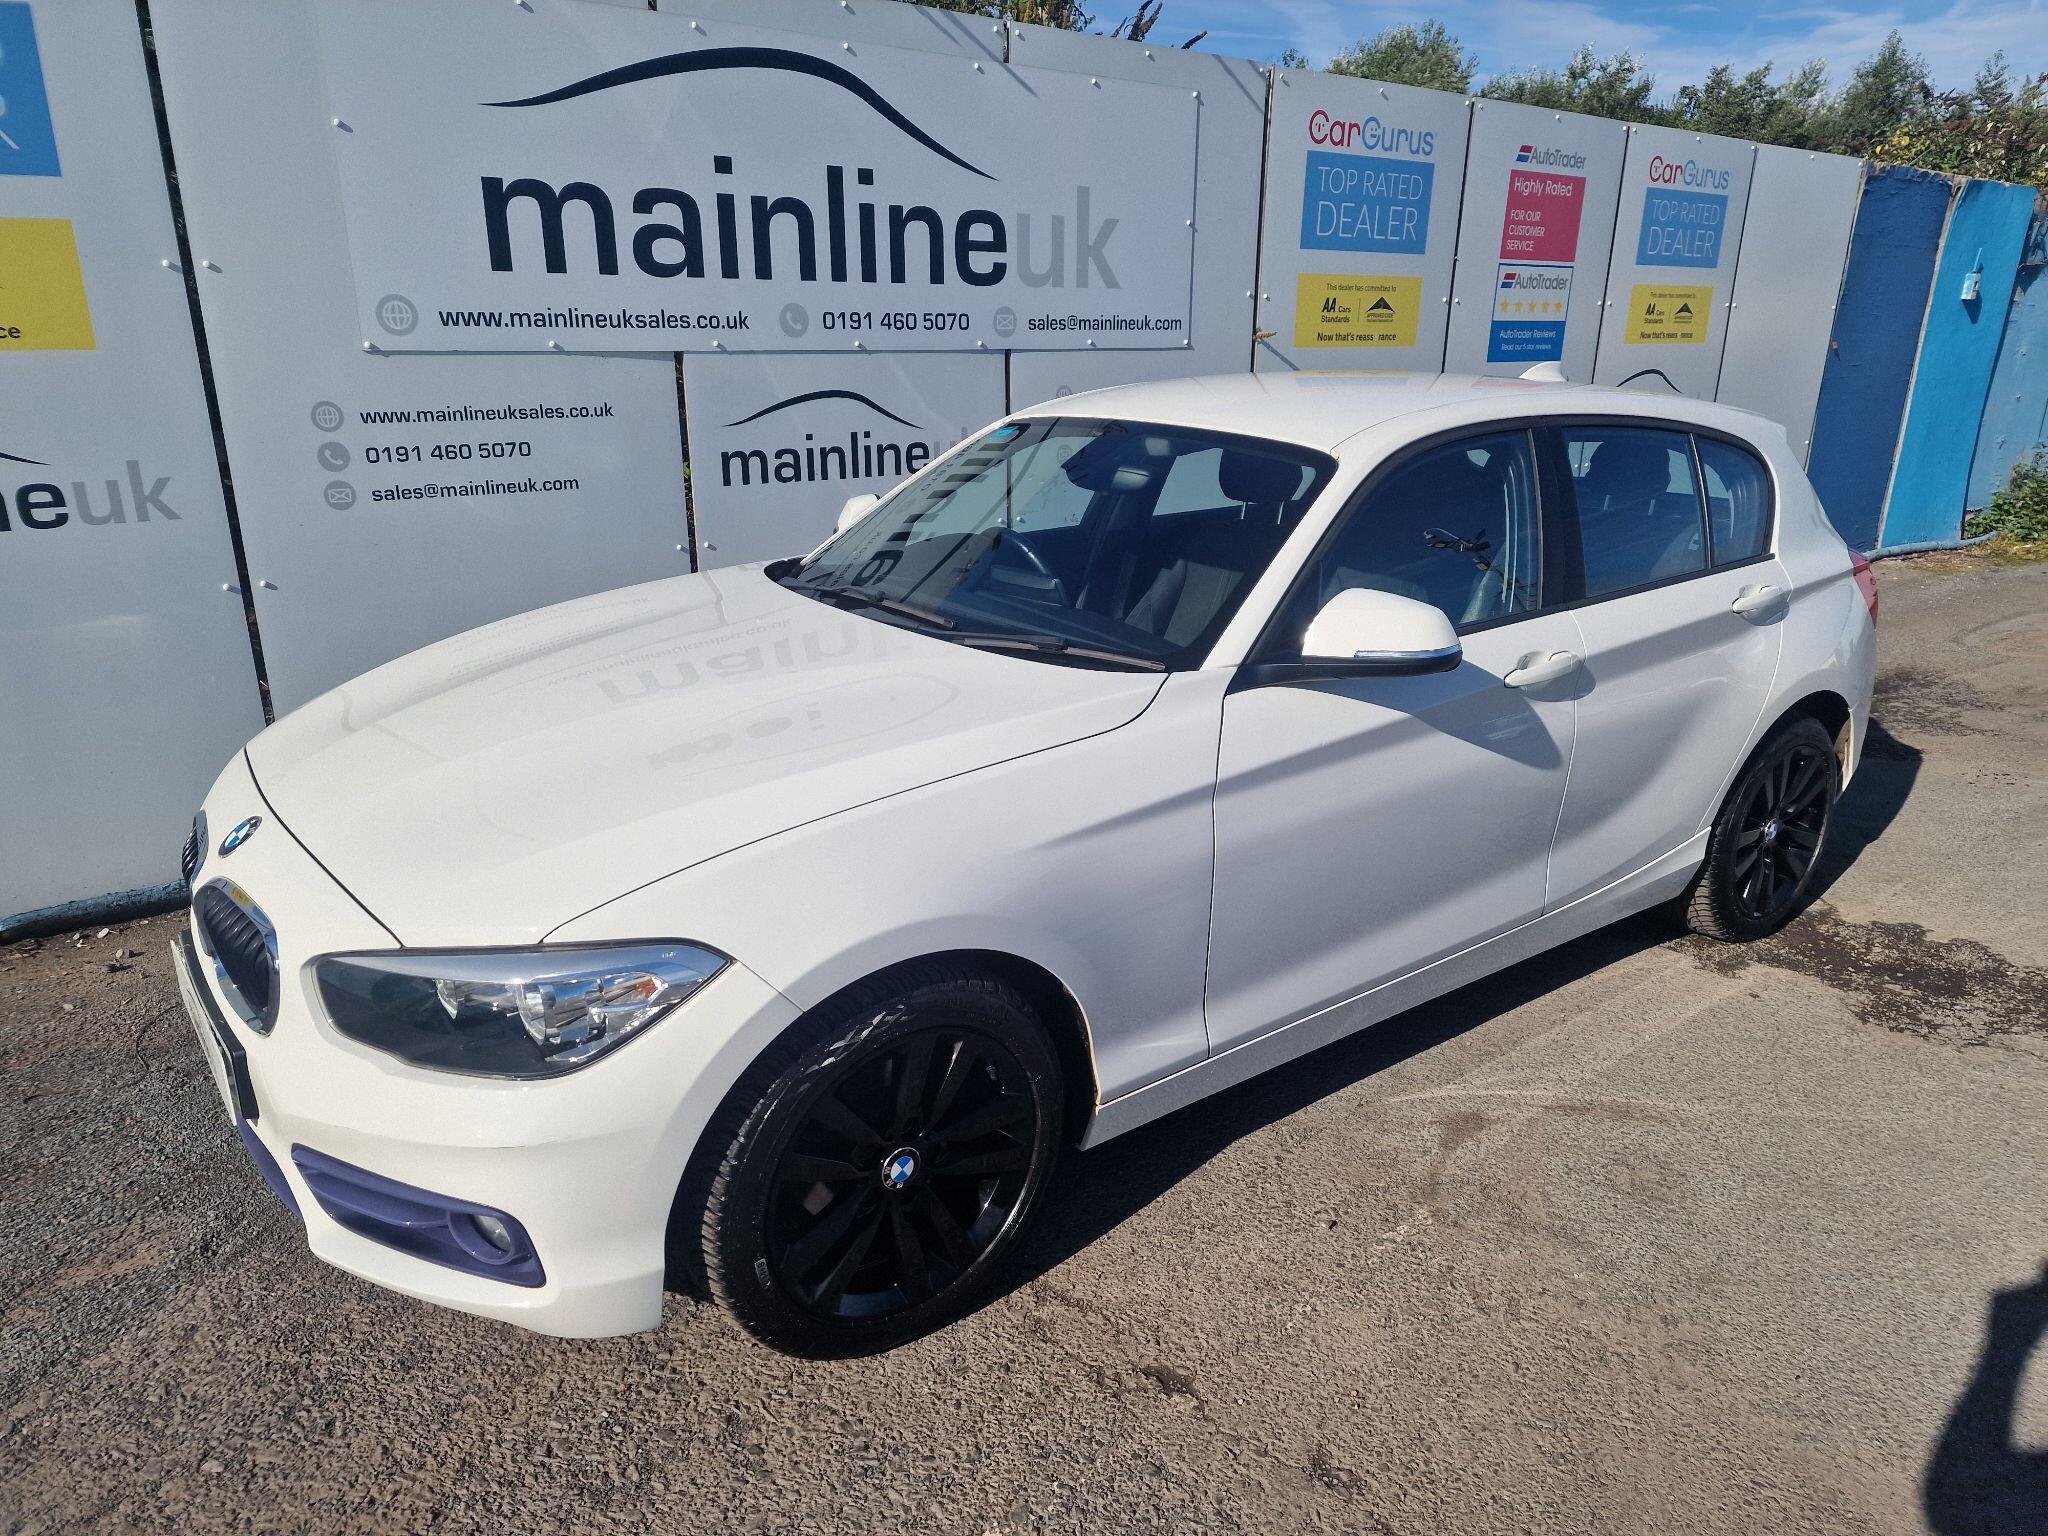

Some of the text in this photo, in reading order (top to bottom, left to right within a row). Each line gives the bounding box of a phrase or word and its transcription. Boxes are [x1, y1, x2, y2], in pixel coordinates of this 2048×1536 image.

[1309, 109, 1434, 156] CarGurus
[1530, 146, 1587, 169] AutoTrader
[1318, 166, 1423, 200] TOP RATED
[1650, 155, 1730, 190] CarGurus
[1514, 177, 1573, 196] Highly Rated
[481, 155, 1122, 289] mainlineuk
[1316, 201, 1418, 240] DEALER
[1510, 210, 1541, 221] FOR OUR
[1652, 199, 1720, 225] TOP RATED
[1508, 225, 1545, 237] CUSTOMER
[1647, 226, 1715, 257] DEALER
[1506, 240, 1535, 251] SERVICE
[1514, 273, 1569, 290] AutoTrader
[1322, 297, 1351, 313] AA Cars
[438, 307, 750, 329] www.mainlineuksales.co.uk
[823, 311, 970, 331] 0191 460 5070
[1028, 314, 1182, 331] sales@mainlineuk.com
[1320, 315, 1350, 323] Standards
[1317, 332, 1334, 341] Now
[1335, 332, 1355, 341] that's
[1500, 330, 1556, 339] AutoTrader Reviews
[360, 402, 615, 424] www.mainlineuksales.co.uk
[365, 441, 531, 463] 0191 460 5070
[371, 477, 580, 502] sales@mainlineuk.com
